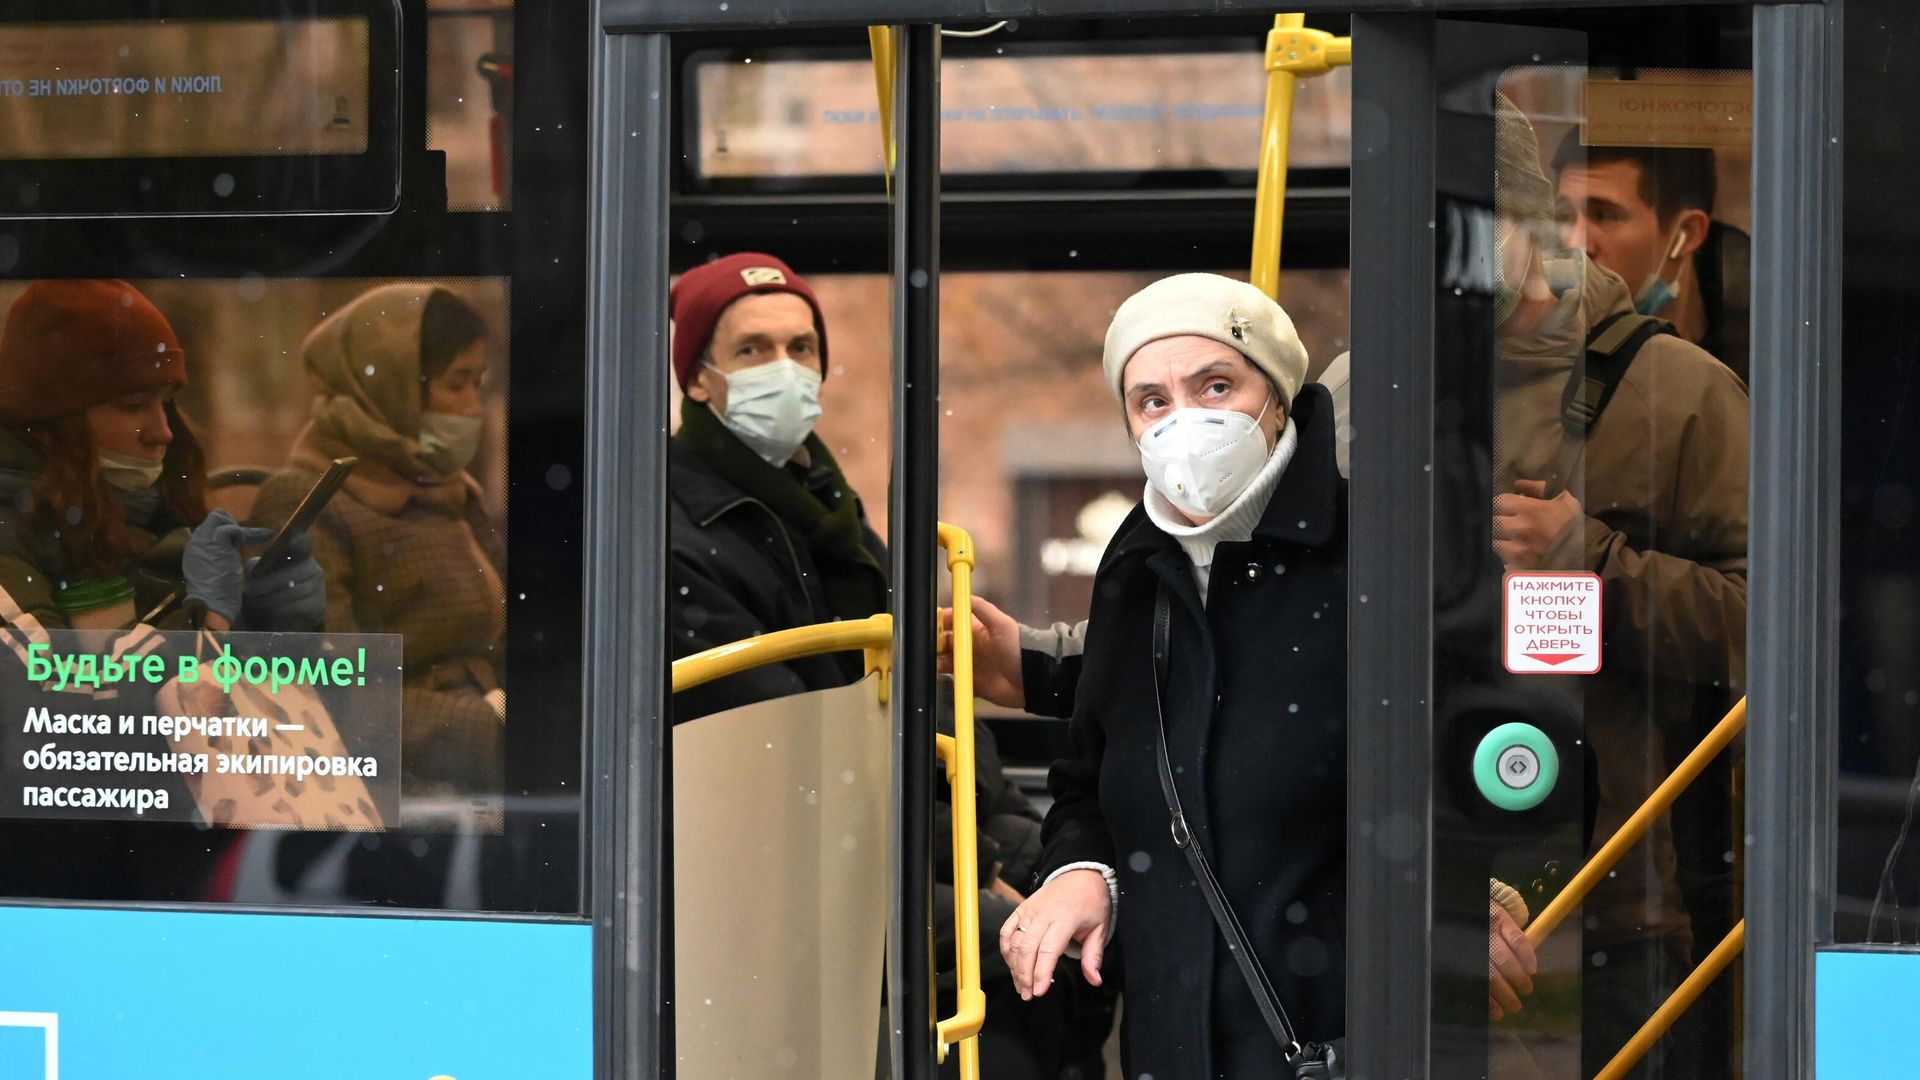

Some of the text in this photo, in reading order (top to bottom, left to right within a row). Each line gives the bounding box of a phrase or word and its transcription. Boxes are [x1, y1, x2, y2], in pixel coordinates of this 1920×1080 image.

[1513, 581, 1594, 591] НАЖМИТЕ
[1521, 596, 1586, 605] КНОПКУ
[1525, 610, 1582, 620] ЧТОБЫ
[1514, 624, 1593, 634] ОТКРЫТЬ
[1526, 639, 1581, 651] ДВЕРЬ
[27, 643, 366, 694] Будьте в форме!
[23, 707, 111, 734] Маска
[119, 715, 135, 735] и
[142, 715, 268, 742] перчатки
[23, 742, 378, 782] обязательная экипировка
[23, 786, 169, 815] пассажира
